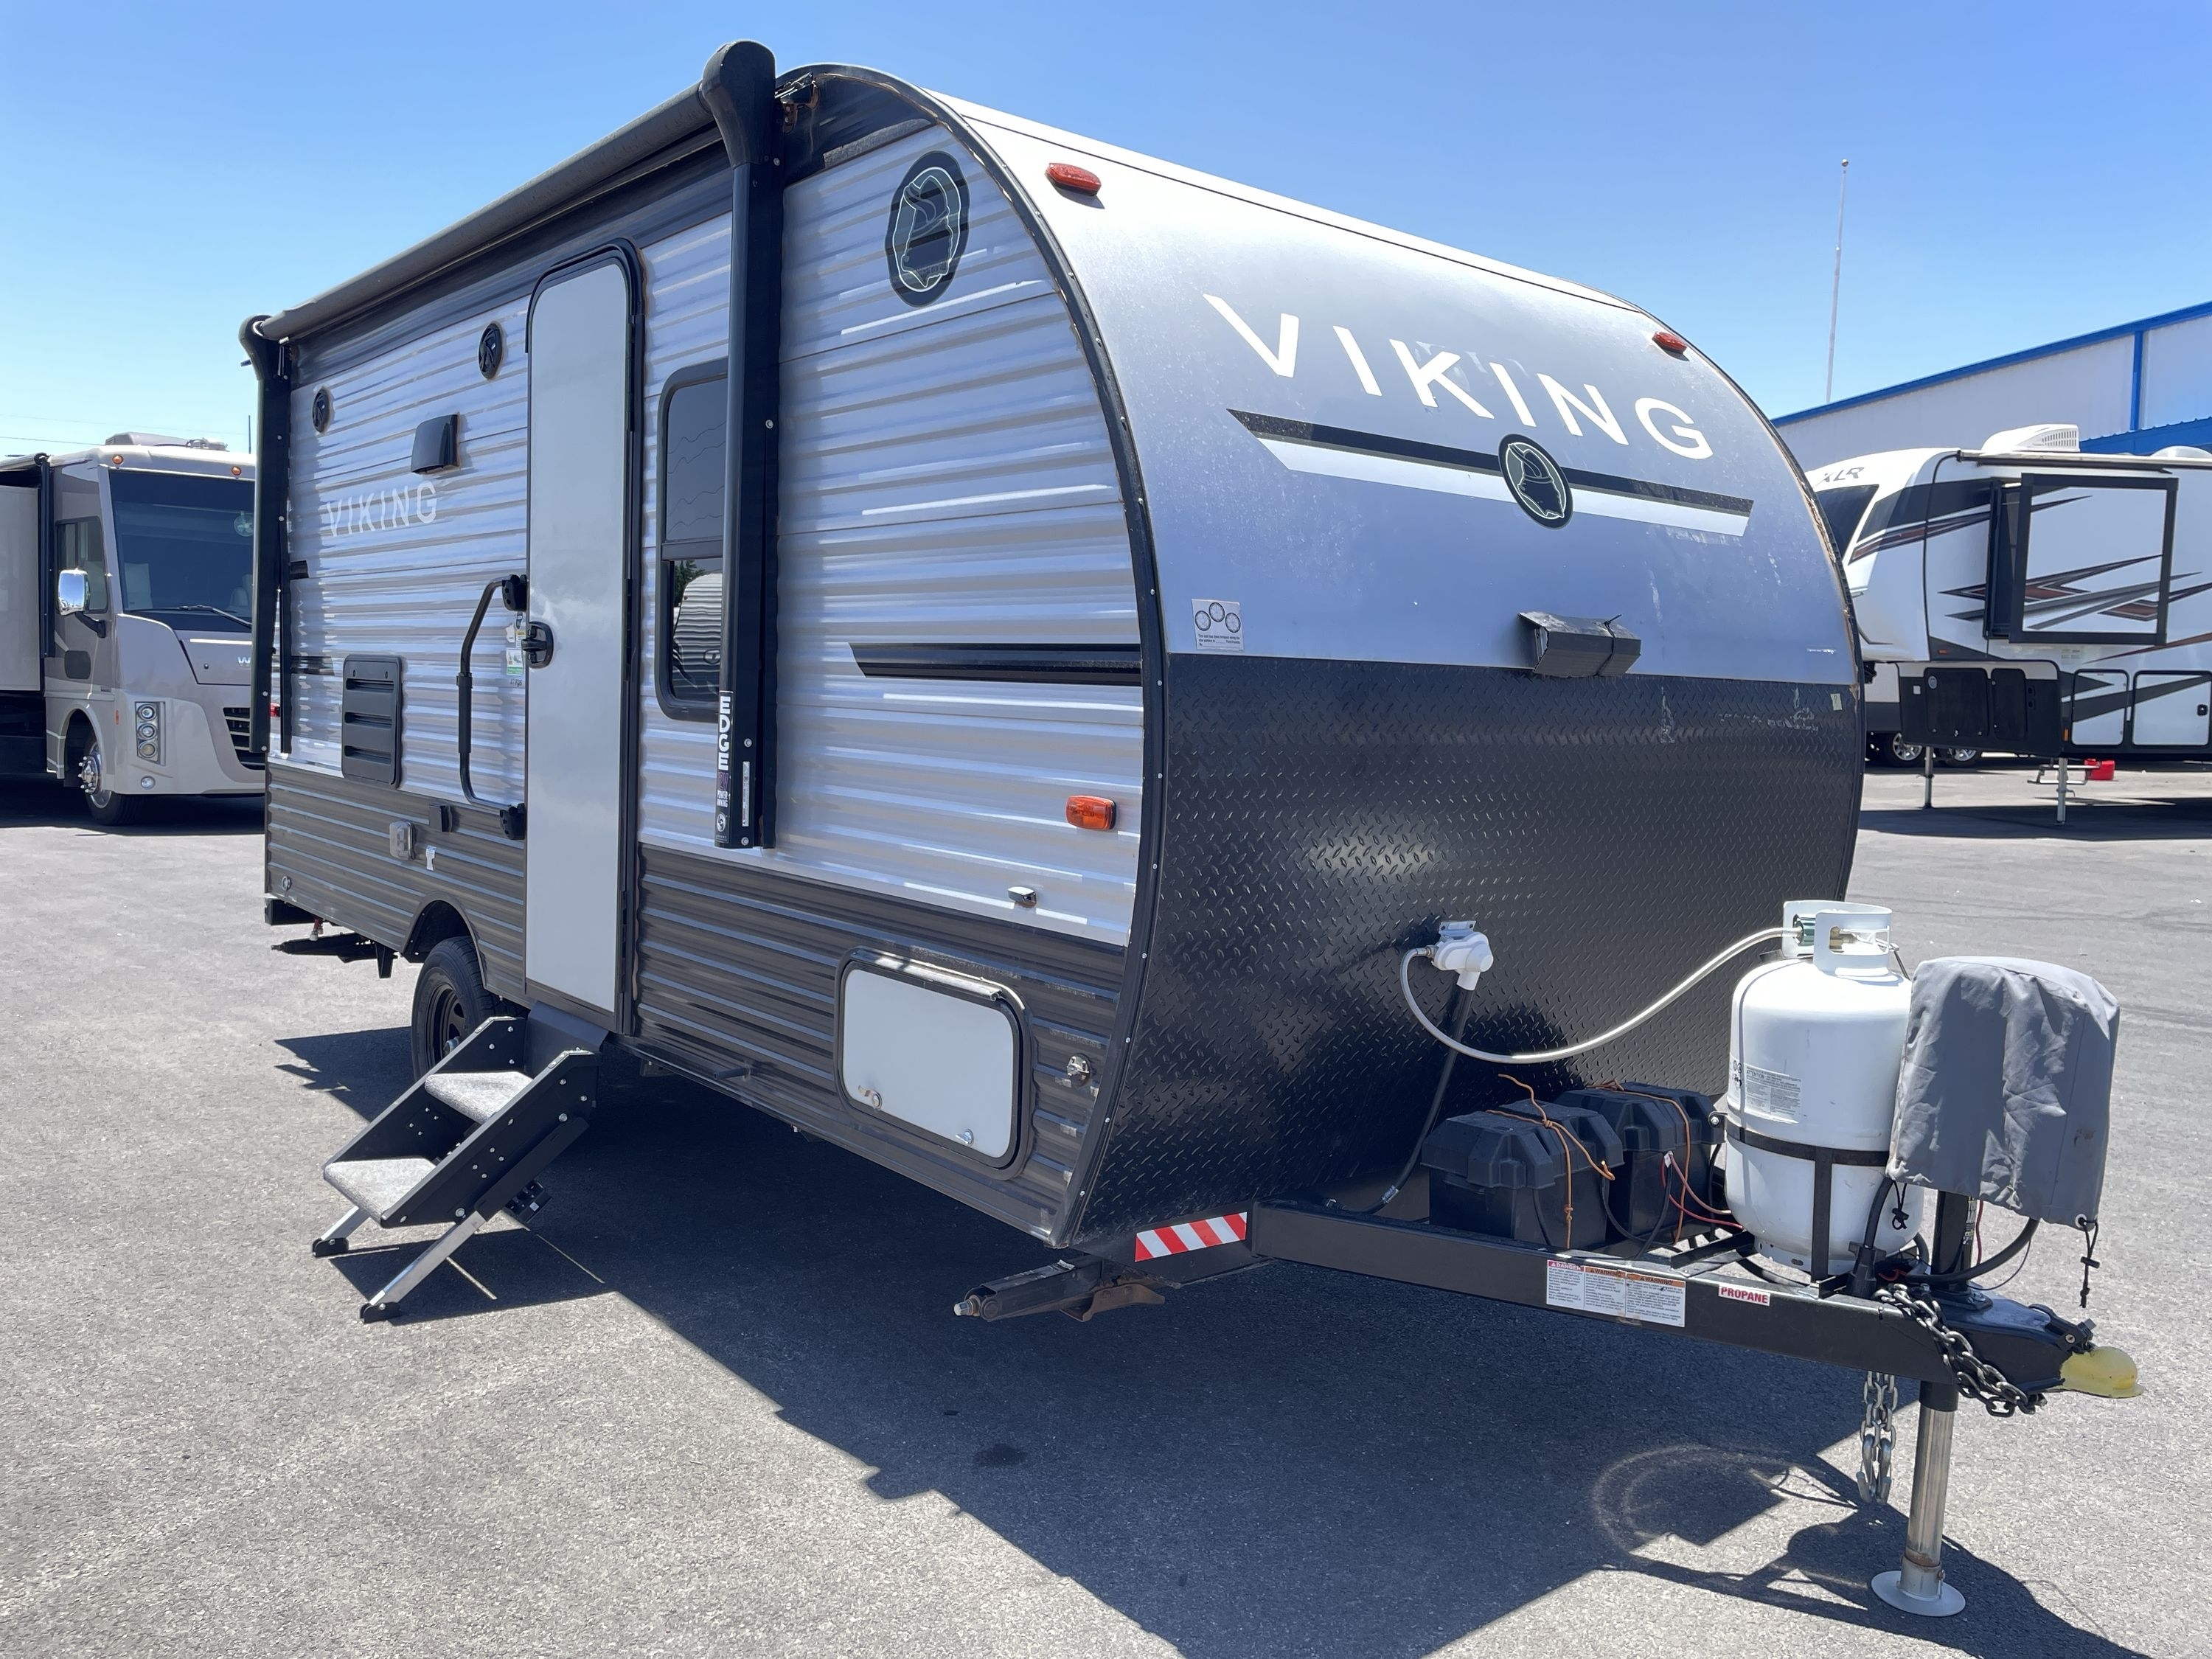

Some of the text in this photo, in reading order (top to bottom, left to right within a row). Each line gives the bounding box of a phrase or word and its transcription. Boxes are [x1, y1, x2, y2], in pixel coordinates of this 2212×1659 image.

[1203, 293, 1713, 459] VIKING
[327, 481, 437, 537] VIKING
[718, 695, 731, 771] EDGE
[1557, 1262, 1582, 1270] DANGER
[1595, 1268, 1621, 1277] WARNING
[1645, 1277, 1672, 1285] WARNING
[1721, 1287, 1768, 1304] PROPANE
